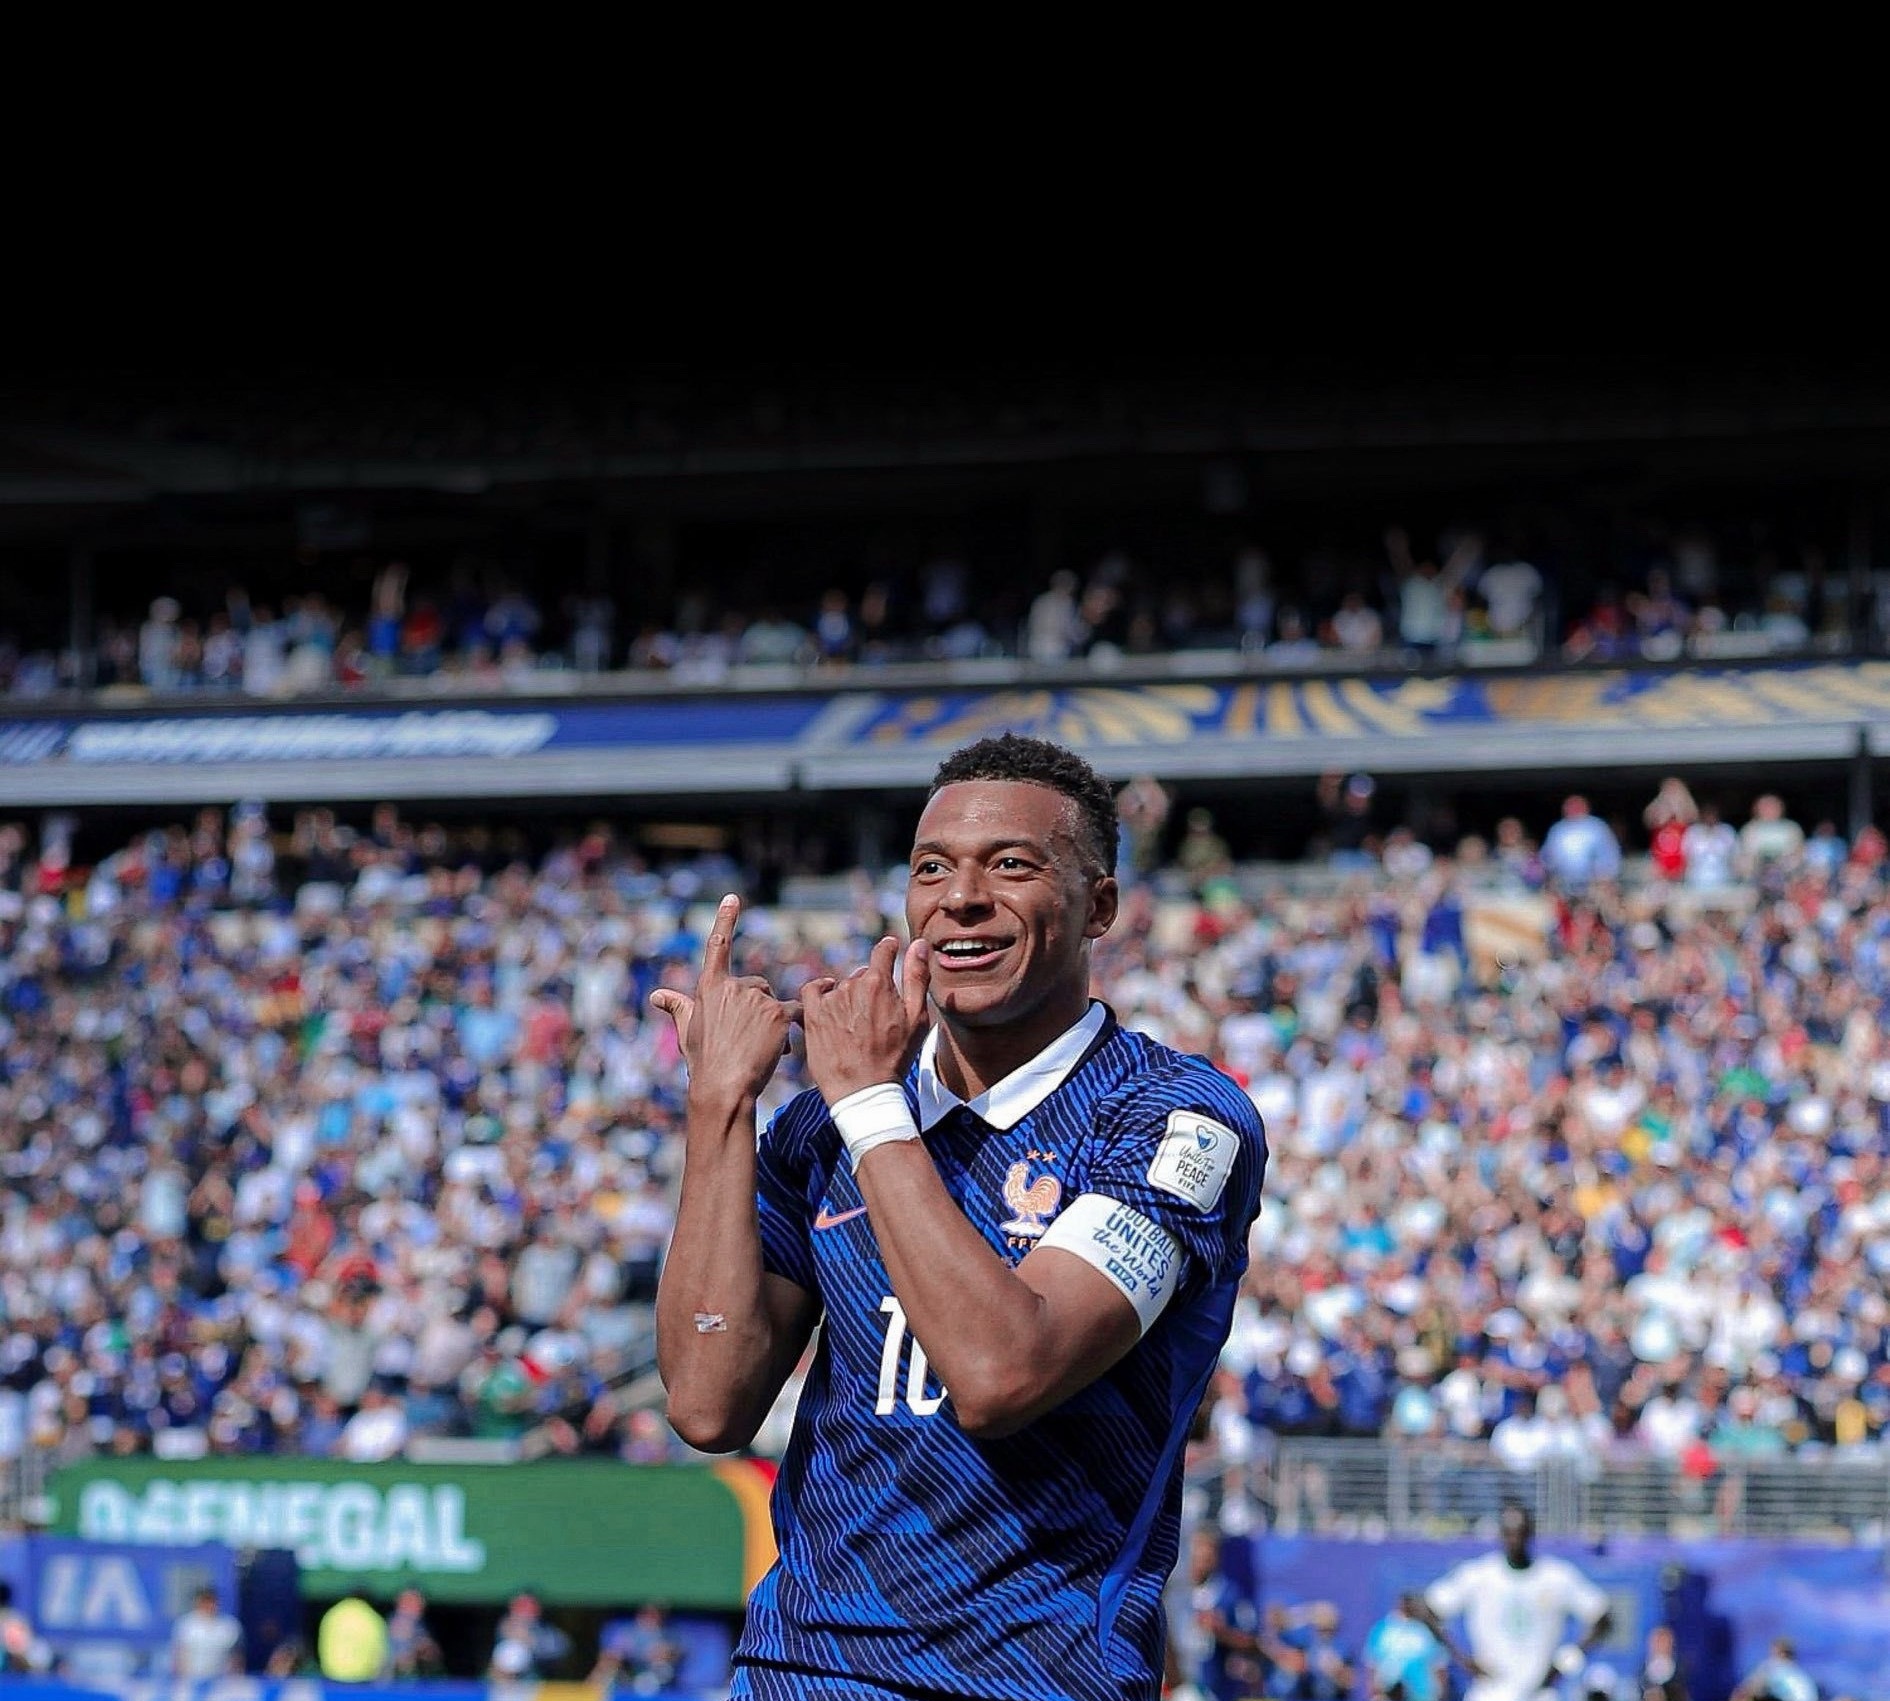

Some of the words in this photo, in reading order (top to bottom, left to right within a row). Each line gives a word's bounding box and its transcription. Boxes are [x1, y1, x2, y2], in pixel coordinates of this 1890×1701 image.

[1175, 1159, 1210, 1189] PEACE
[1092, 1226, 1121, 1253] the
[1122, 1249, 1163, 1300] World
[1106, 1212, 1169, 1280] UNITES
[1116, 1203, 1177, 1264] FOOTBALL
